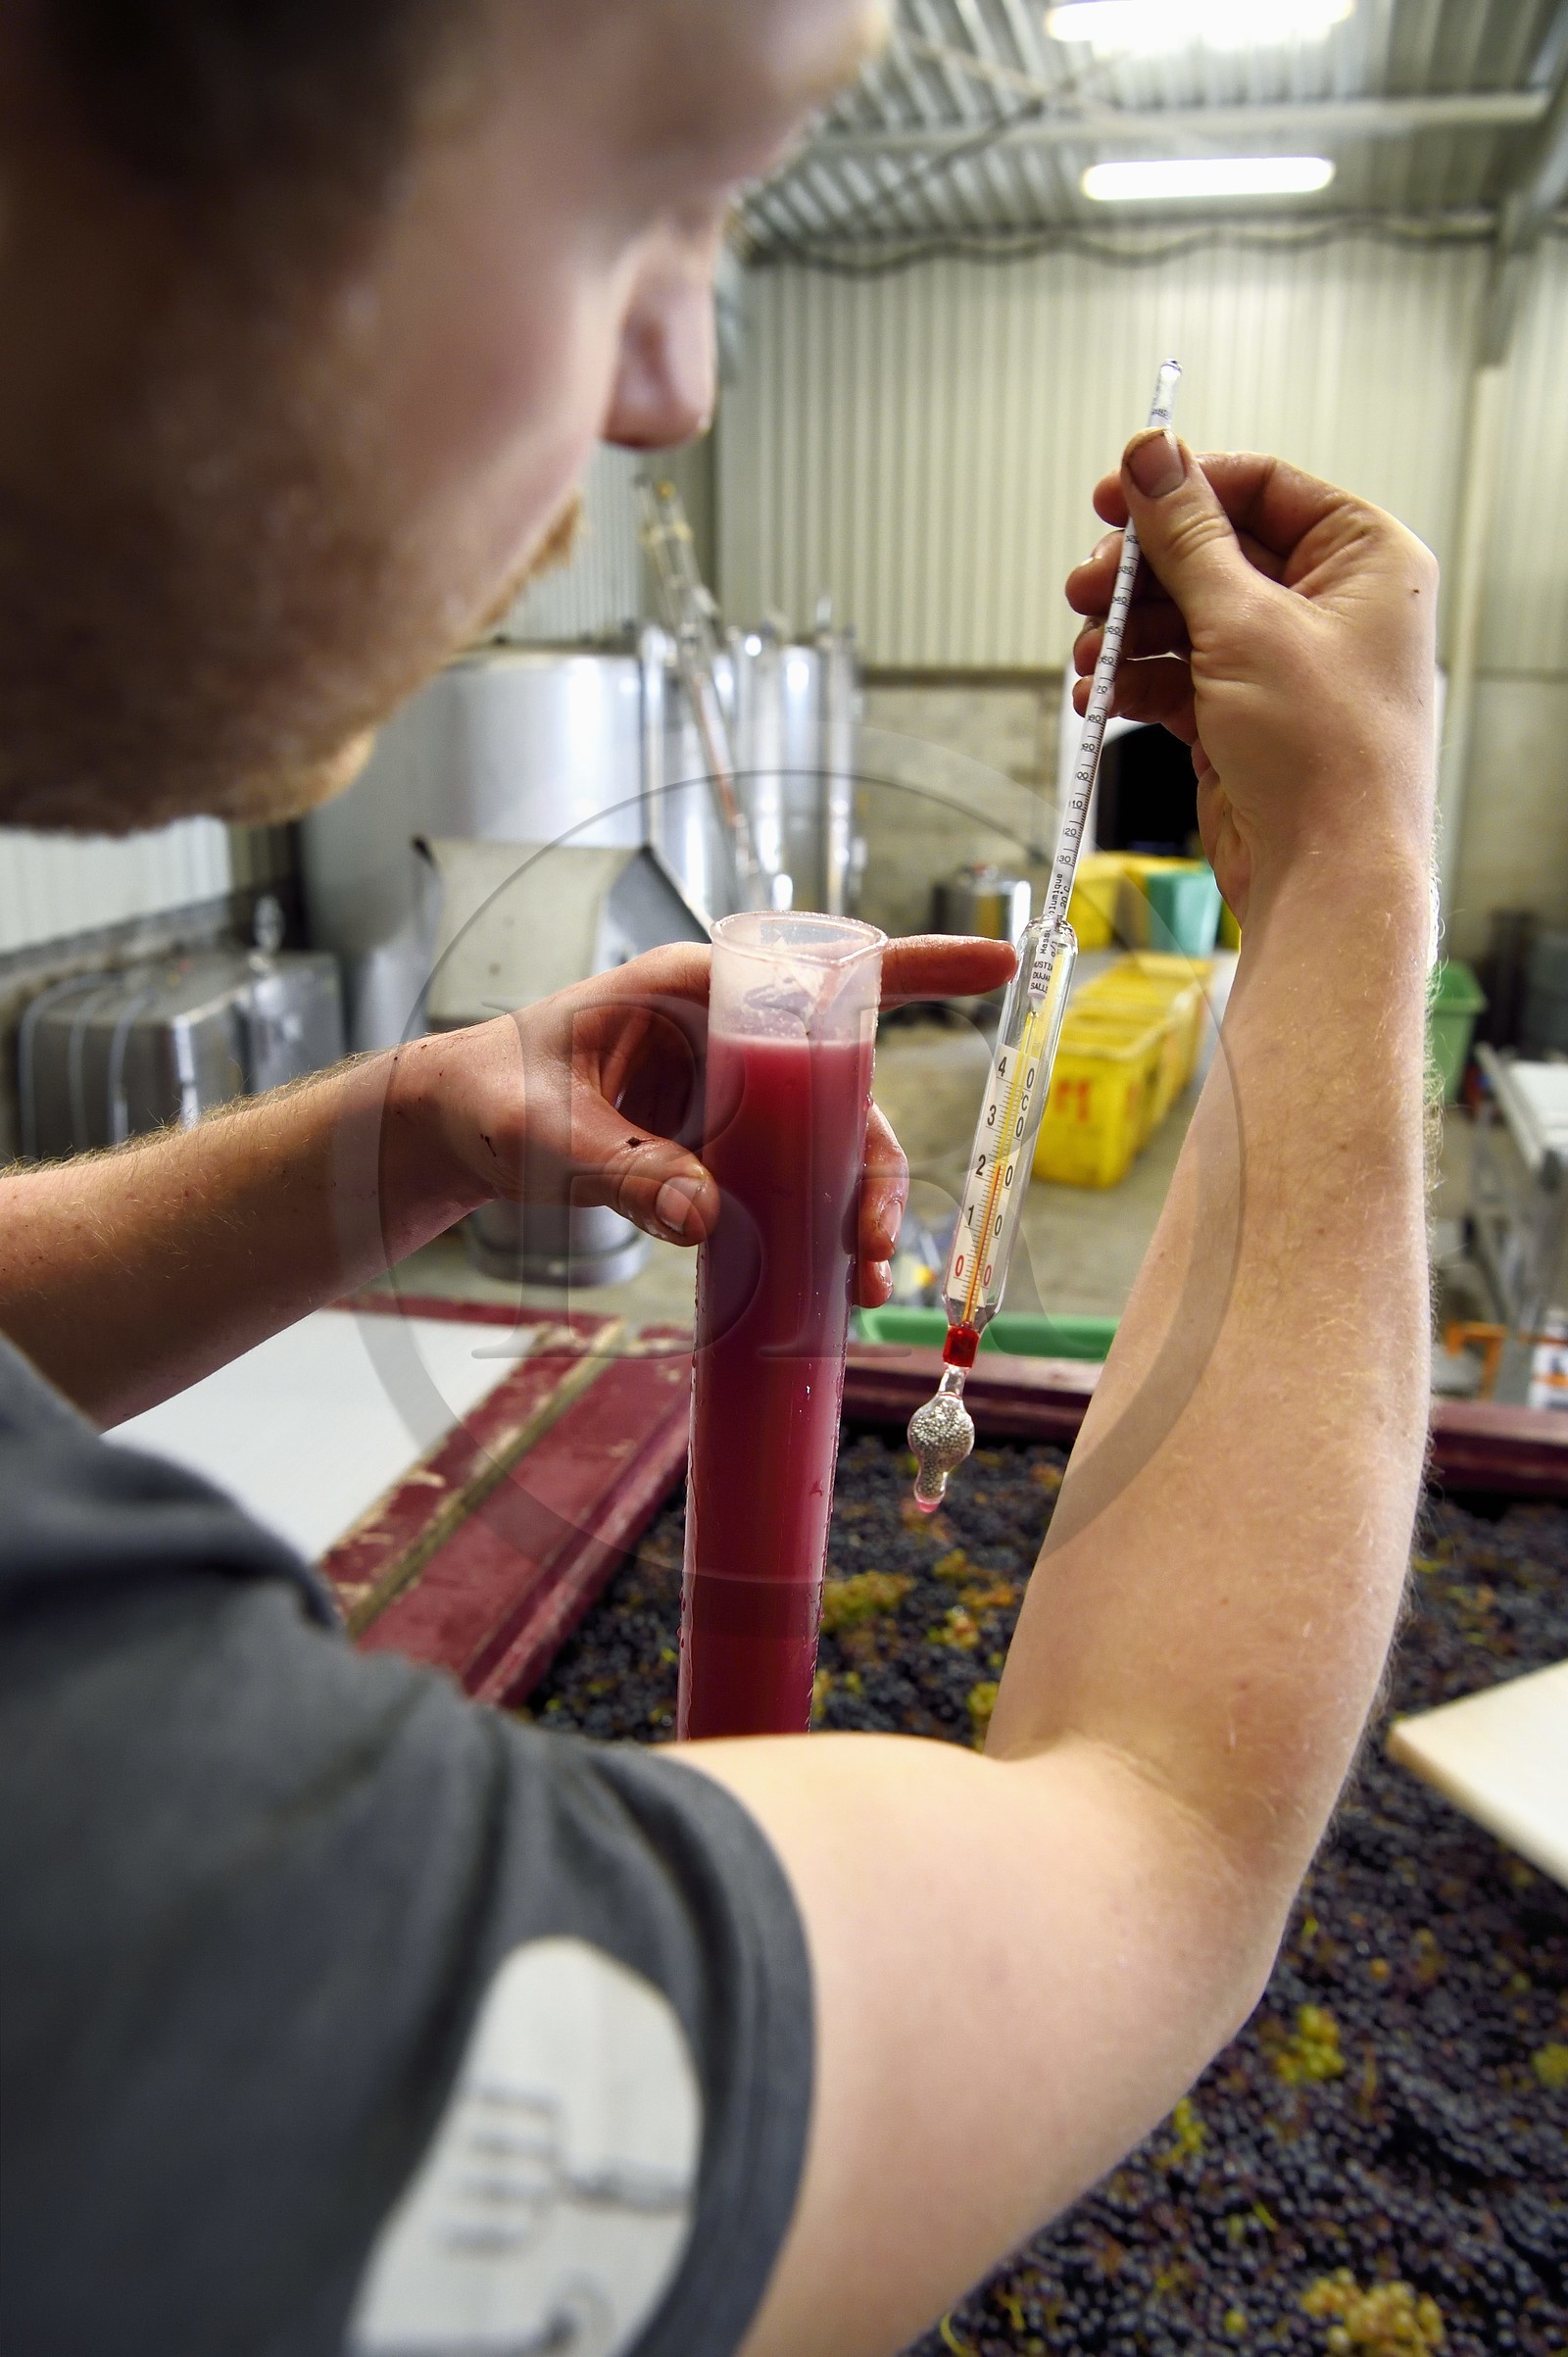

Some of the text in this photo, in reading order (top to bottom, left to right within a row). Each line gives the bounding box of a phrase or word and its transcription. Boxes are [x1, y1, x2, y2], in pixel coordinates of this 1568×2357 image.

[1049, 873, 1063, 916] olumique
[998, 1056, 1007, 1077] 4
[987, 1105, 997, 1126] 3
[976, 1154, 986, 1176] 2
[968, 1204, 975, 1226] 1
[955, 1254, 964, 1277] 0
